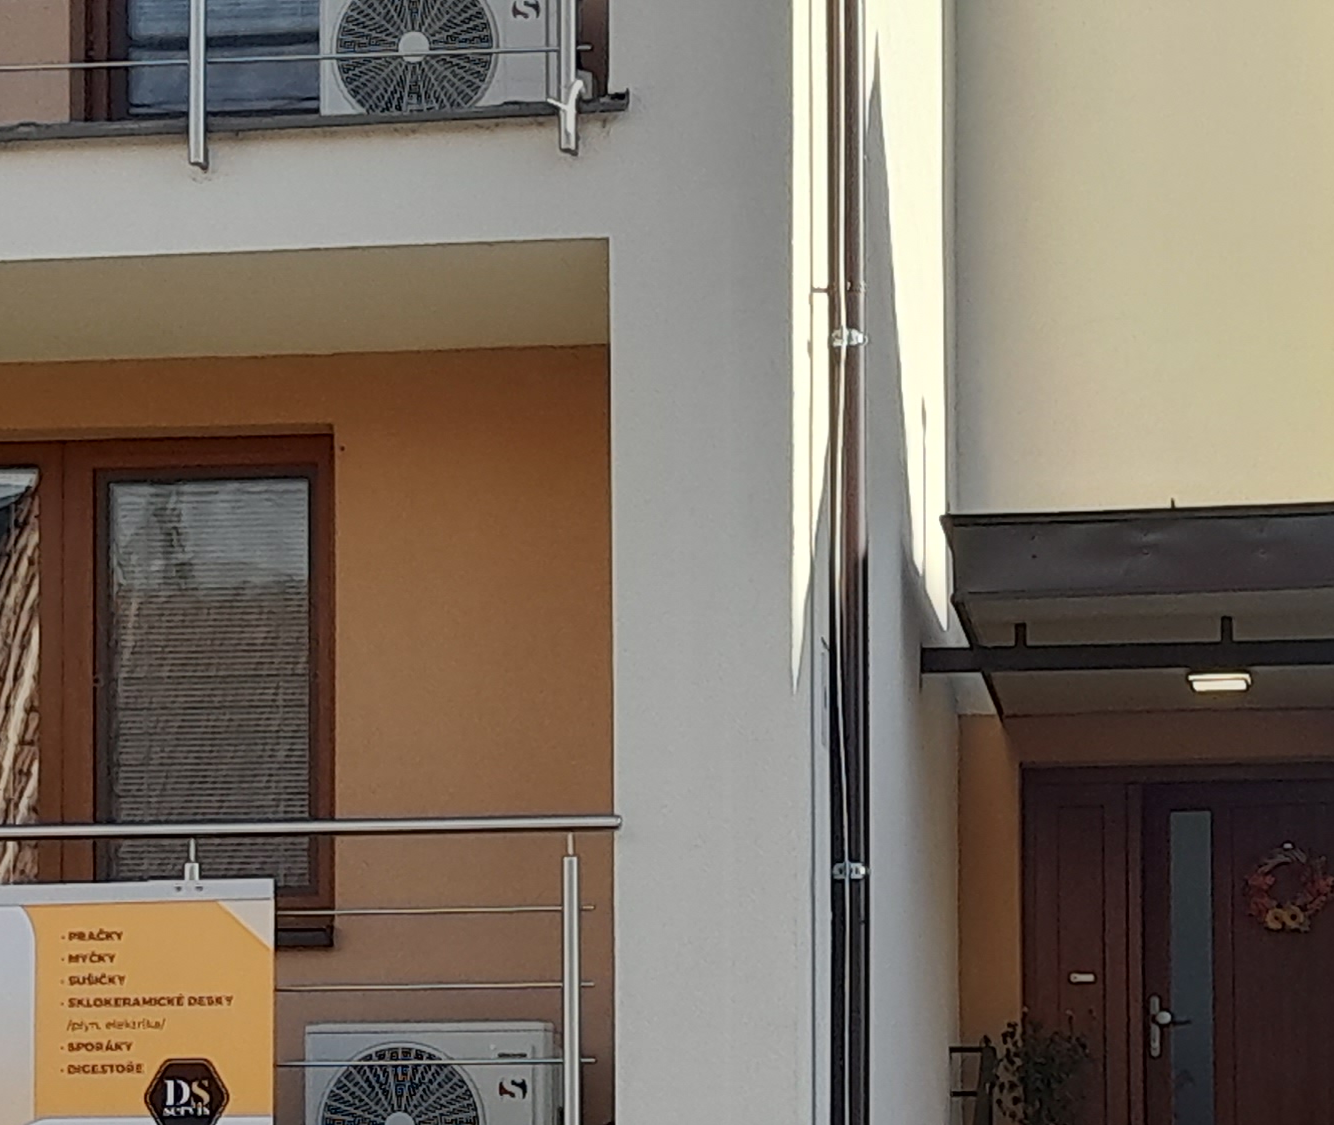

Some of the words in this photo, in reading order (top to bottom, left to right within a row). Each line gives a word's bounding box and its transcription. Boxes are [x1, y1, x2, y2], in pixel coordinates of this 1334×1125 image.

[68, 928, 123, 942] PRAČKY
[68, 951, 116, 964] MYČKY
[67, 994, 184, 1009] SKLOKERAMICKÉ
[67, 1039, 133, 1052] SPORÁKY
[163, 1078, 211, 1107] DS
